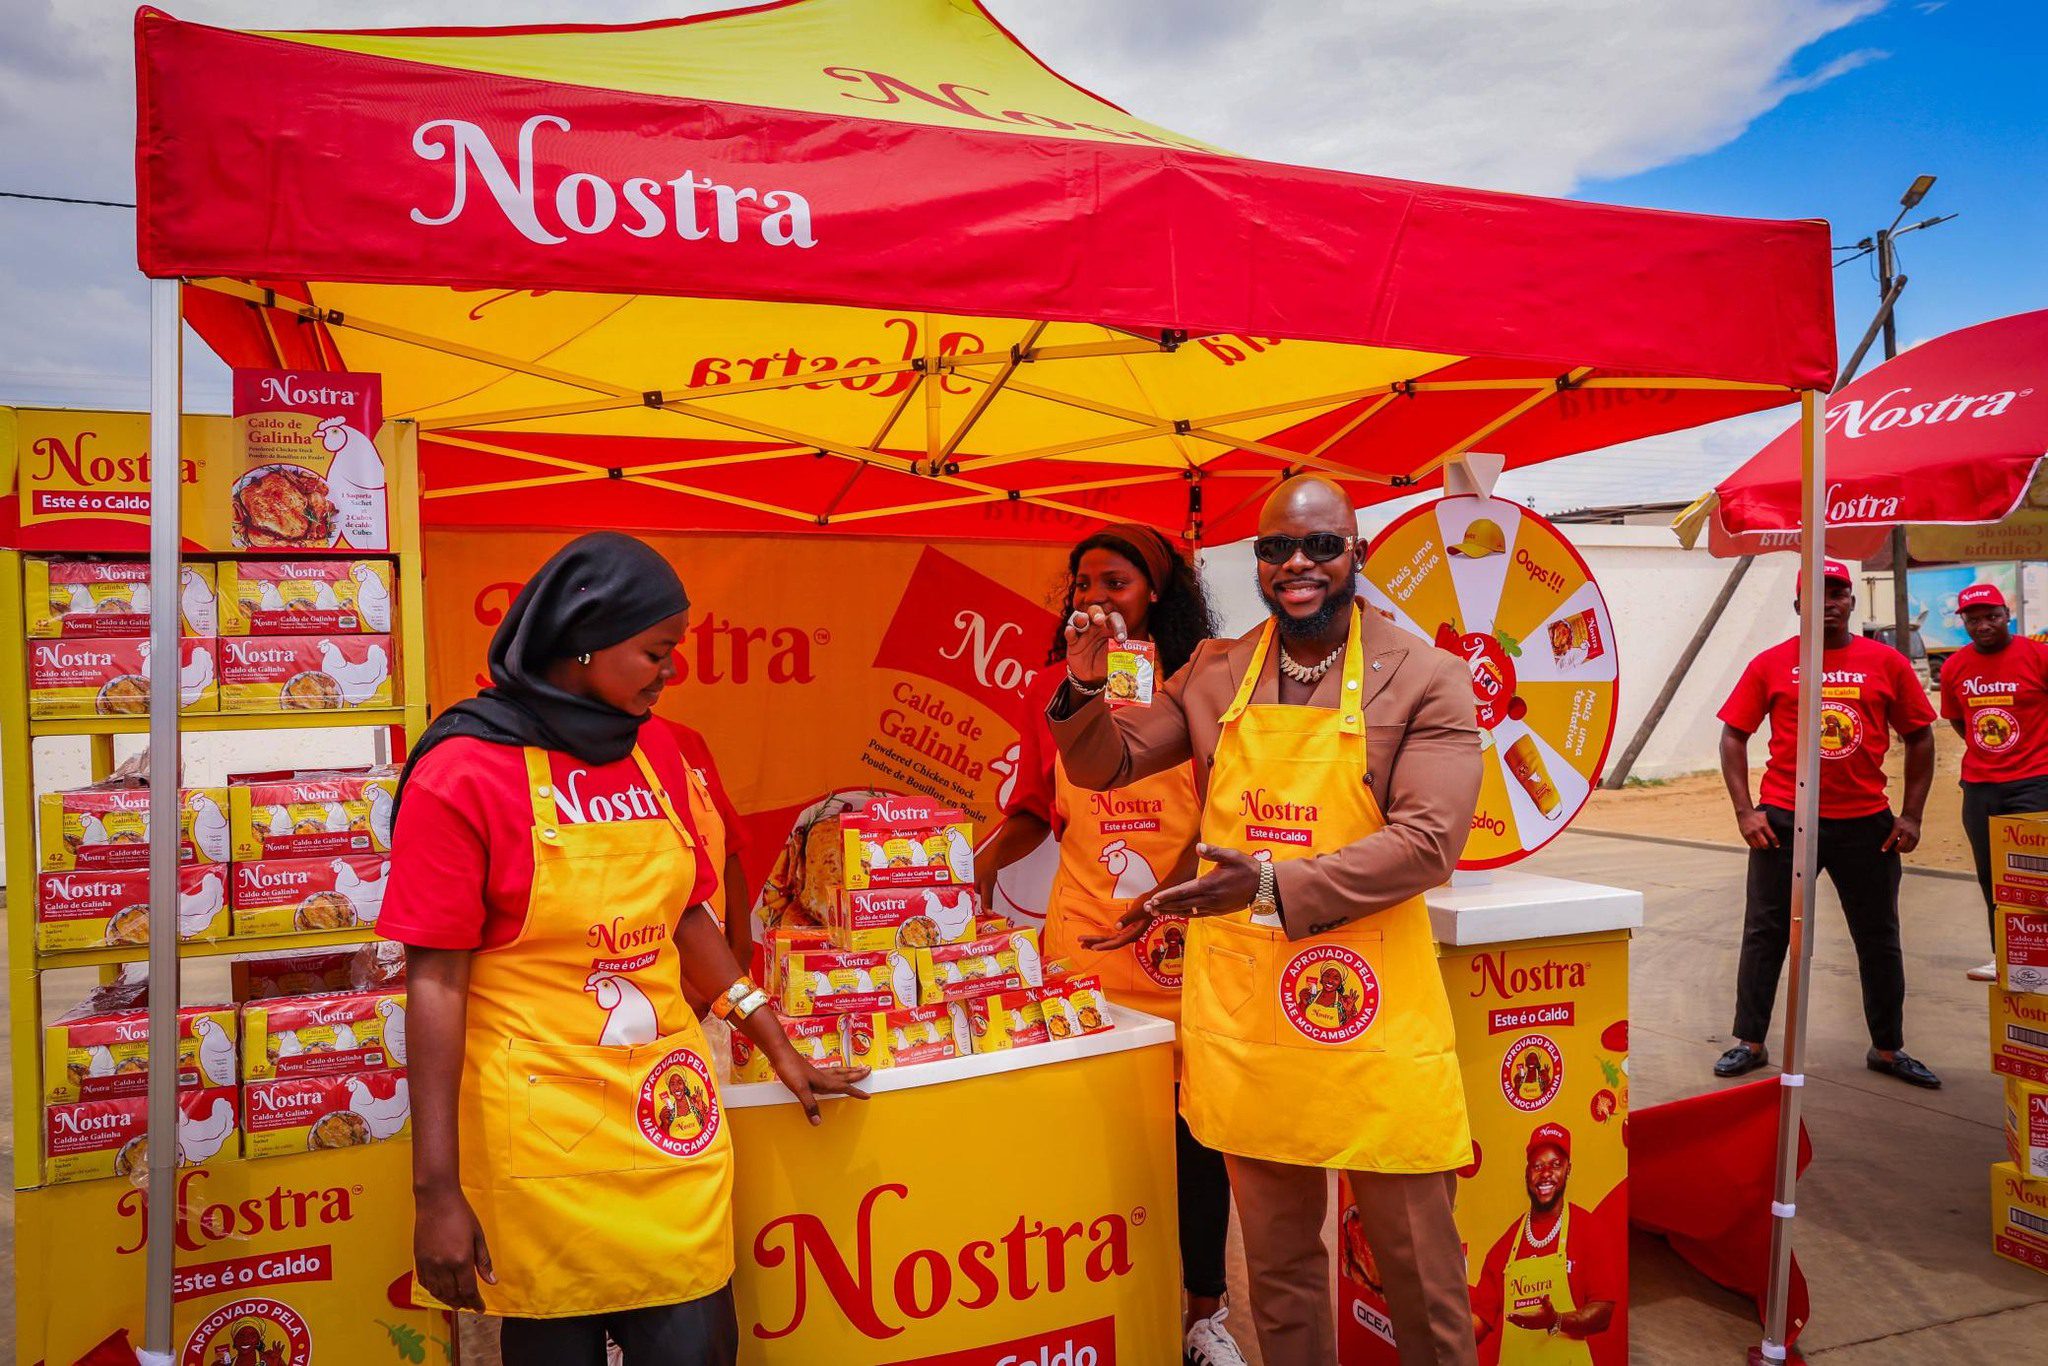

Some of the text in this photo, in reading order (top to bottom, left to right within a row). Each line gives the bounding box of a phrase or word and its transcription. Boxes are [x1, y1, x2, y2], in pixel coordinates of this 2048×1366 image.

[410, 115, 819, 248] Nostra
[261, 375, 355, 406] Nostra
[249, 418, 302, 429] Caldo de
[1825, 387, 2017, 439] Nostra
[249, 431, 312, 445] Galinha
[32, 432, 199, 486] Nosta
[42, 495, 150, 510] Este é o Caldo
[96, 566, 146, 580] Nostra
[280, 564, 326, 578] Nostra
[1386, 540, 1434, 595] Mais uma
[1397, 554, 1440, 602] tentativa
[1516, 549, 1566, 594] Oops!!!
[66, 620, 92, 629] Nostra
[254, 618, 277, 627] Nostra
[1586, 617, 1598, 649] Nostra
[36, 643, 112, 668] Nostra
[225, 641, 296, 665] Nostra
[1962, 676, 2016, 696] Nostra
[893, 682, 983, 742] Caldo de
[1565, 690, 1586, 750] tentativa
[1575, 689, 1597, 757] Mais uma
[880, 708, 984, 782] Galinha
[868, 738, 976, 800] Powdered Chicken Stock
[294, 786, 338, 801] Nostra
[862, 752, 988, 824] Poudre de Bouillon Poulet
[872, 800, 929, 822] Nostra
[1091, 790, 1162, 816] Nostra
[1239, 788, 1318, 822] Nostra
[1122, 822, 1126, 830] é
[1134, 821, 1156, 829] Caldo
[1250, 828, 1307, 842] Este é o Caldo
[48, 854, 64, 862] 42
[79, 853, 106, 862] Nostra
[239, 844, 252, 852] 42
[266, 843, 290, 851] Nostra
[46, 875, 122, 900] Nostra
[239, 864, 308, 889] Nostra
[271, 888, 300, 896] Galinha
[855, 892, 906, 914] Nostra
[45, 900, 112, 911] Caldo de Galinha
[586, 916, 666, 954] Nostra
[2008, 916, 2048, 933] Nost
[960, 942, 994, 957] Nostra
[598, 961, 620, 970] Este
[836, 954, 870, 968] Nostra
[1289, 949, 1375, 991] APROVADO PELA
[1073, 980, 1094, 990] Nostra
[1470, 951, 1585, 1000] Nostra
[1043, 986, 1063, 996] Nostra
[308, 1010, 354, 1025] Nostra
[910, 1008, 936, 1022] Nostra
[1284, 992, 1374, 1040] MÃE MOÇAMBICANA
[1495, 1008, 1568, 1026] Este é o Caldo
[795, 1022, 824, 1036] Nostra
[1504, 1037, 1559, 1068] APROVADO PELA
[279, 1064, 303, 1072] Nostra
[306, 1058, 326, 1066] Caldo
[643, 1052, 709, 1102] APROVADO PELA
[53, 1086, 67, 1095] 42
[83, 1085, 110, 1094] Nostra
[252, 1086, 322, 1111] Nostra
[1504, 1074, 1560, 1109] MÃE MOÇAMBICANA
[54, 1108, 132, 1134] Nostra
[275, 1112, 284, 1120] de
[285, 1109, 313, 1118] Galinha
[642, 1097, 718, 1154] MÃE MOÇAMBICANA
[54, 1131, 121, 1144] Caldo de Galinha
[1540, 1126, 1564, 1138] Nostra
[2005, 1178, 2048, 1208] Nost
[116, 1170, 354, 1254] Nostra
[752, 1184, 1134, 1340] Nostra
[174, 1254, 320, 1294] Este é o Caldo
[1510, 1276, 1552, 1296] Nostra
[190, 1303, 302, 1354] APROVADO PELA
